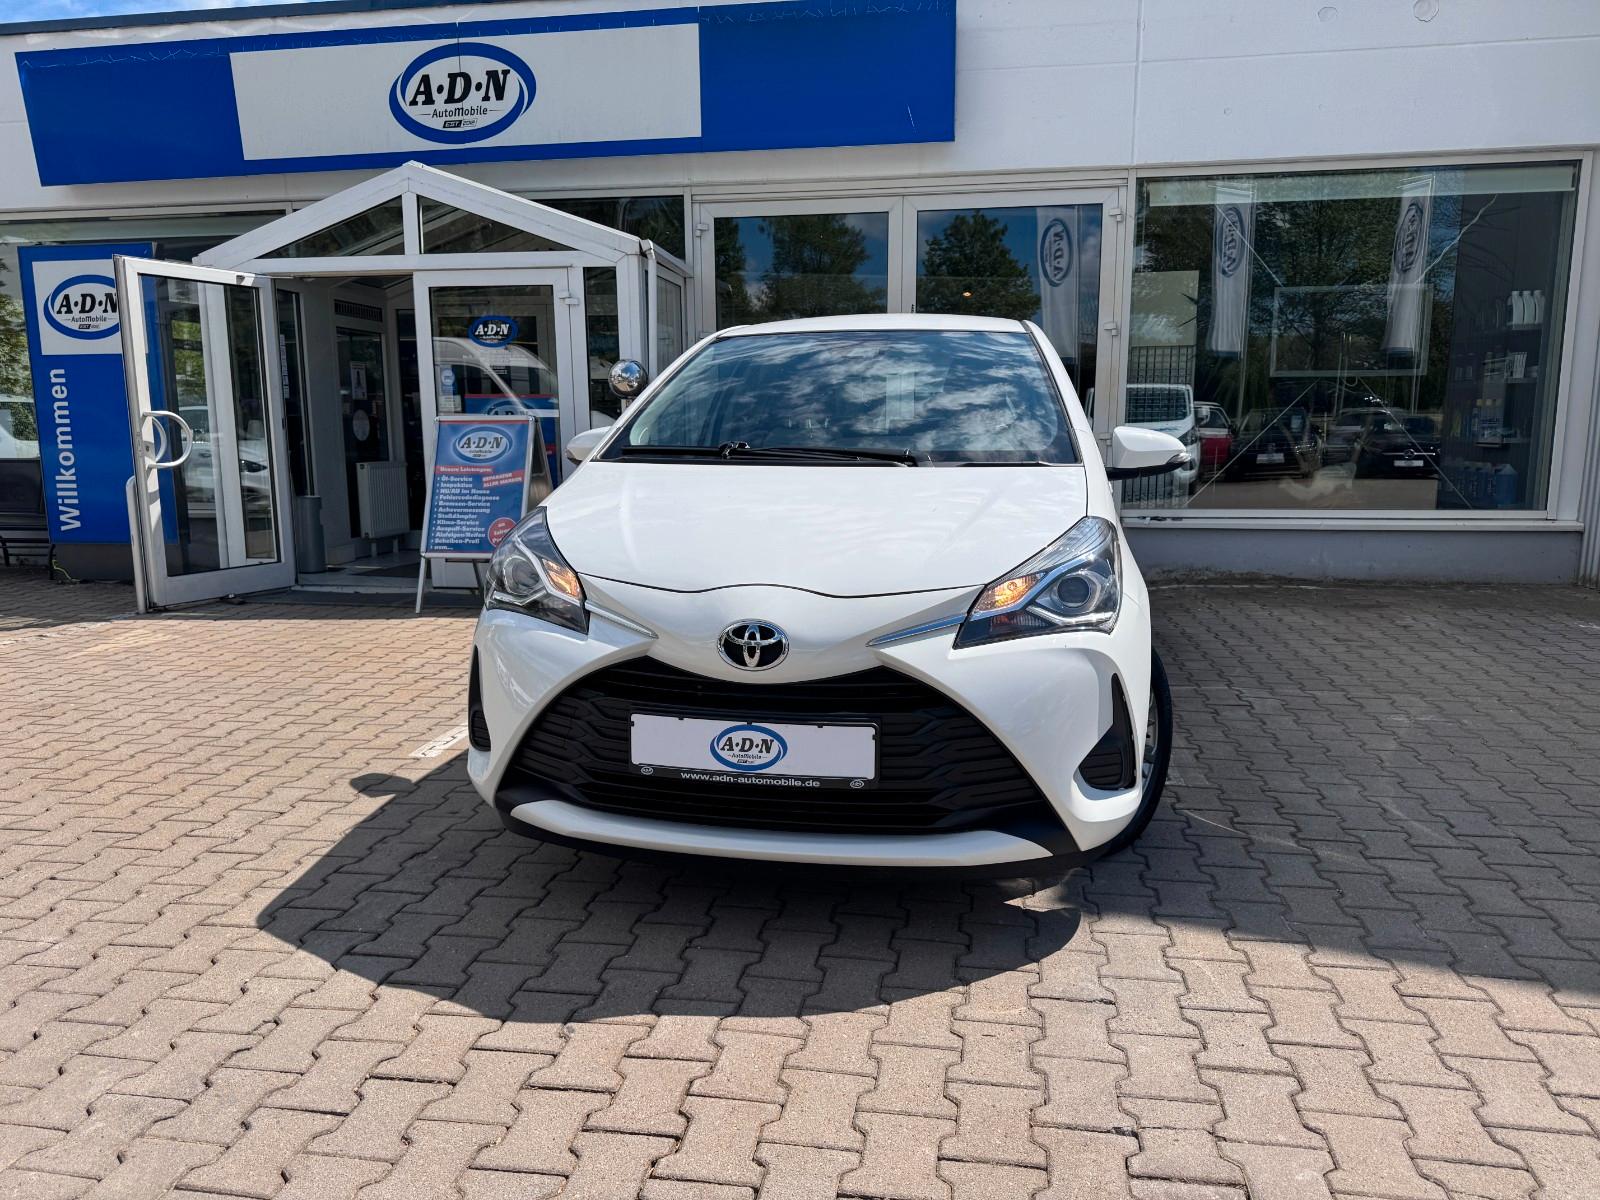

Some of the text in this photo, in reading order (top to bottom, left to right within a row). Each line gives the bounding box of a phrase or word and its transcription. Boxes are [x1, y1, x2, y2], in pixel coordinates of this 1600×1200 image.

[431, 105, 488, 118] AutoMobile
[71, 315, 107, 323] AutoMobile
[50, 368, 82, 531] Willkommen
[681, 771, 821, 788] www.adn-automobile.de
